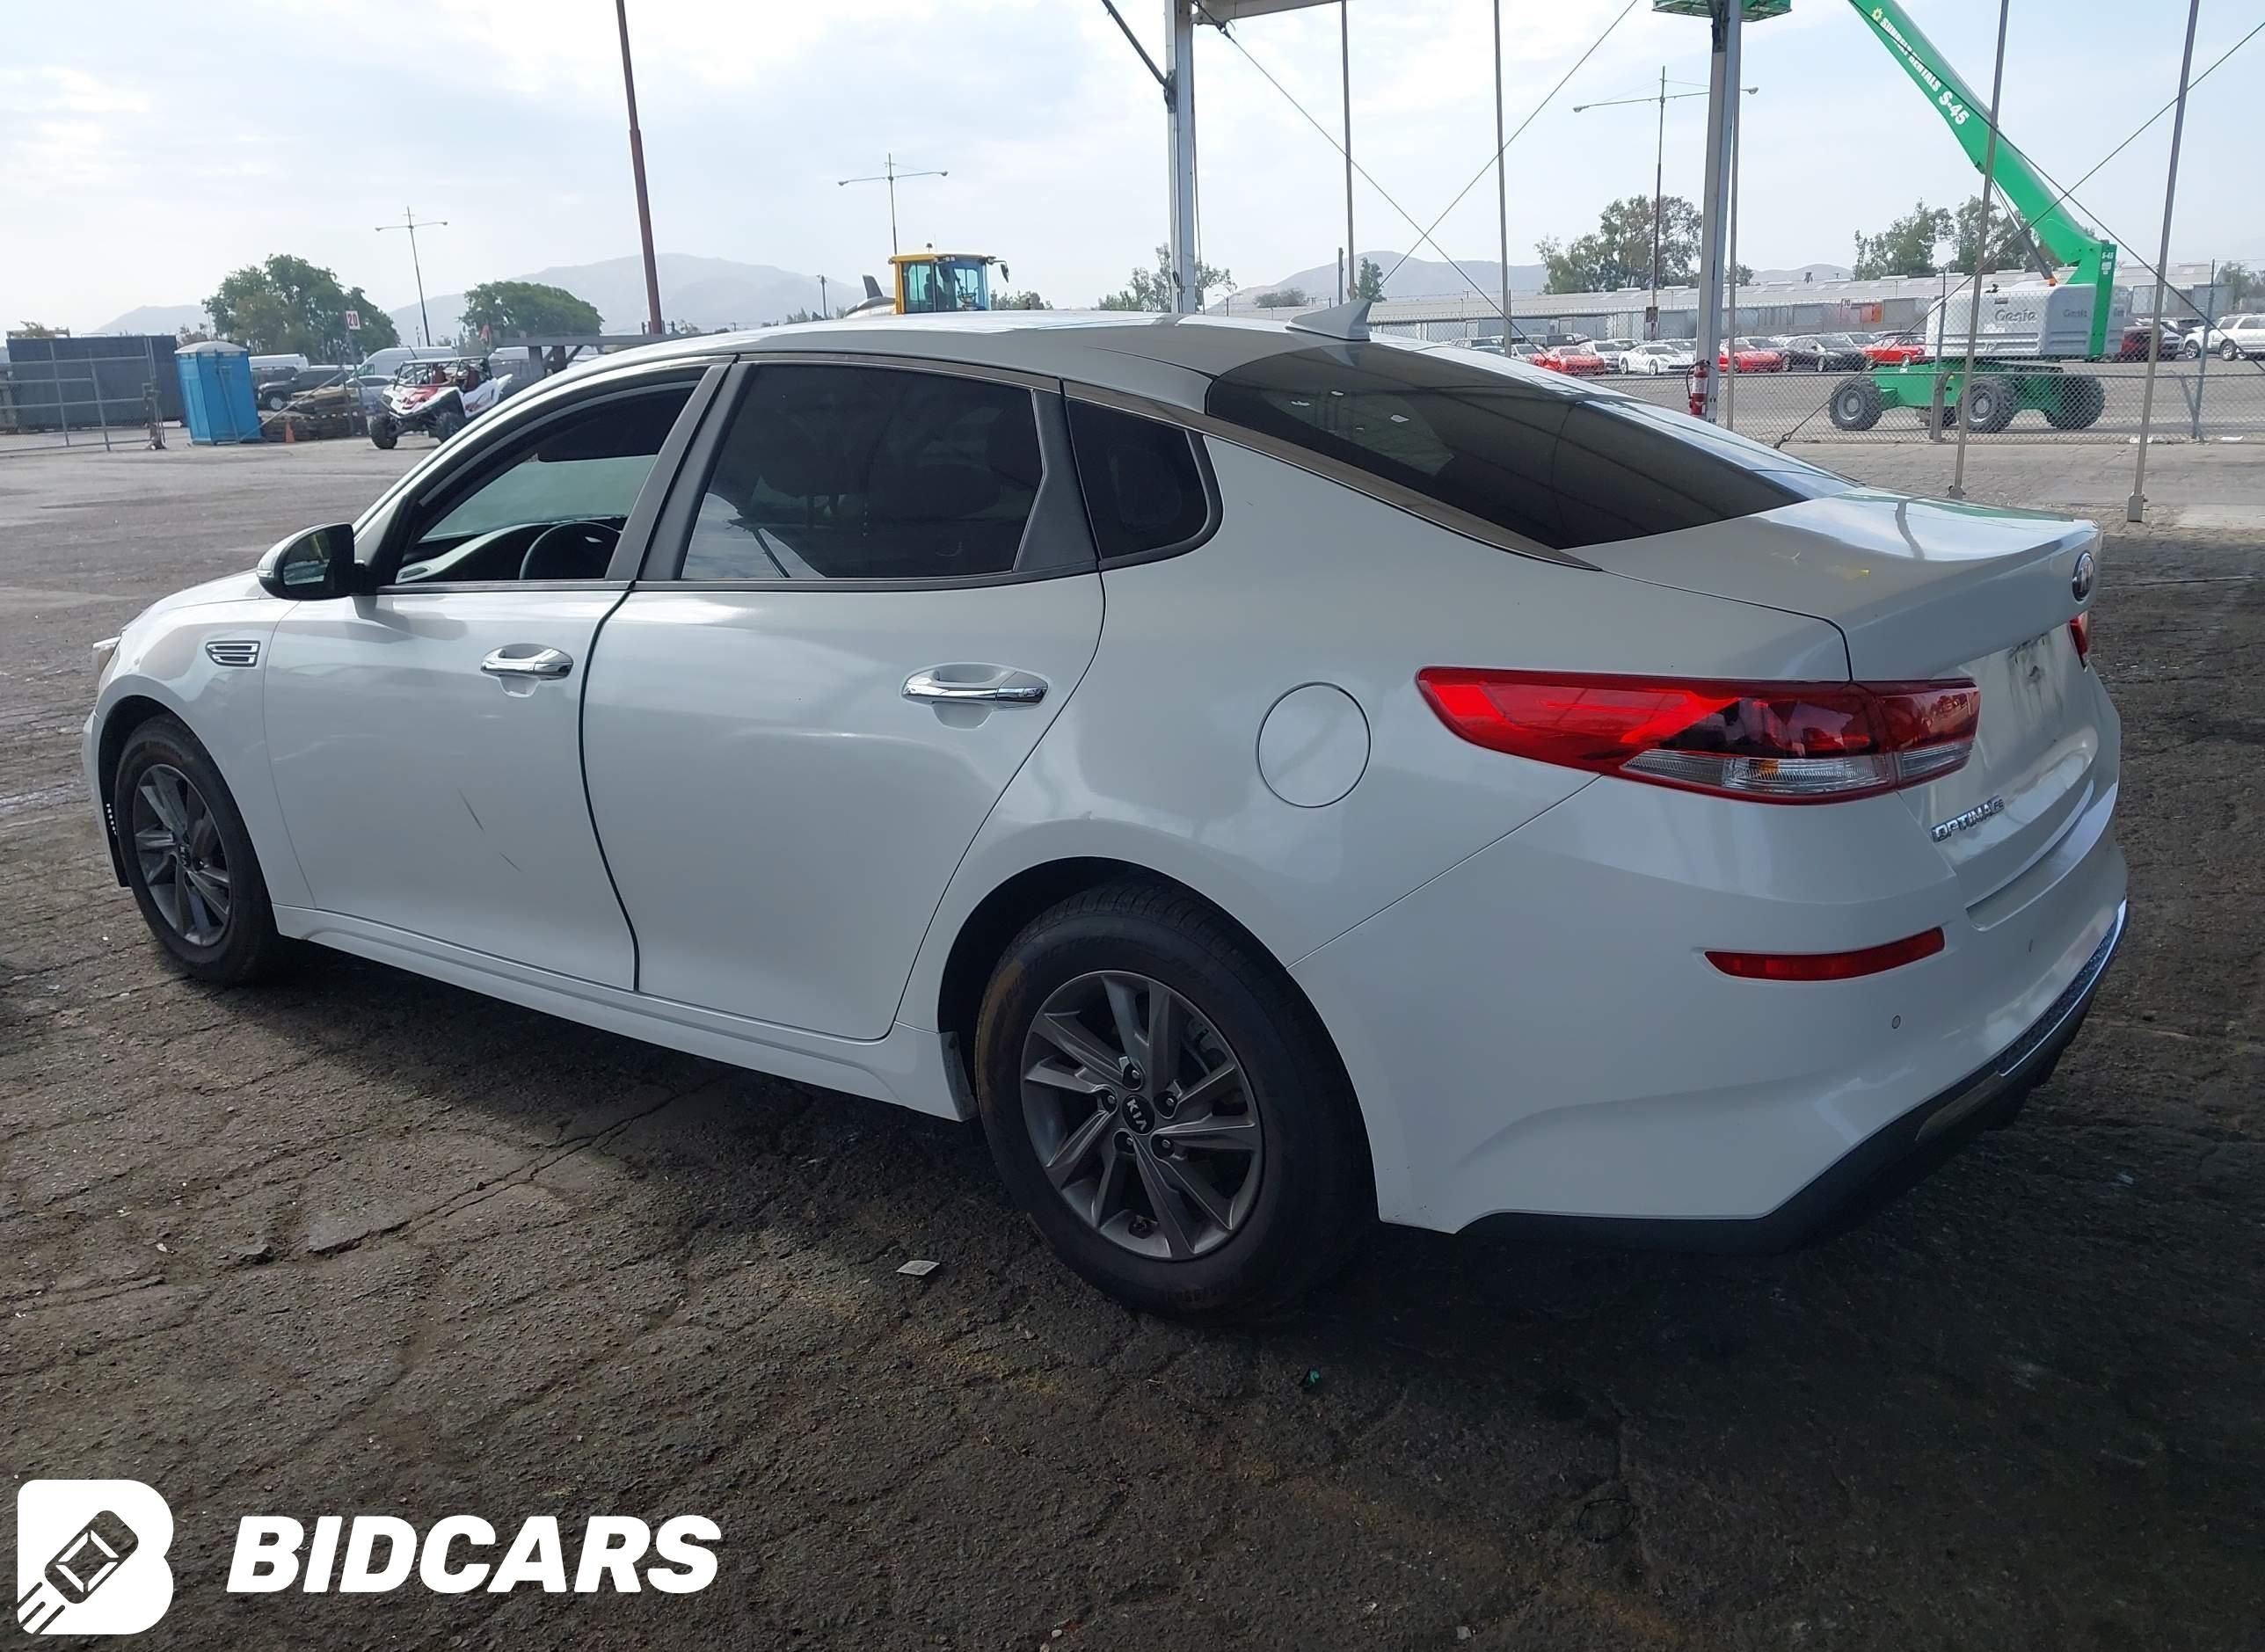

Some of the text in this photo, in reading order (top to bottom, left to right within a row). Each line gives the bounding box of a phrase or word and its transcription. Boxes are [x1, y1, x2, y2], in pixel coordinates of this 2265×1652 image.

[1939, 91, 1970, 125] S-45
[347, 313, 359, 327] 20
[1995, 309, 2037, 323] Genie
[1932, 802, 1992, 841] OPTIMA
[1126, 1098, 1147, 1132] KIA
